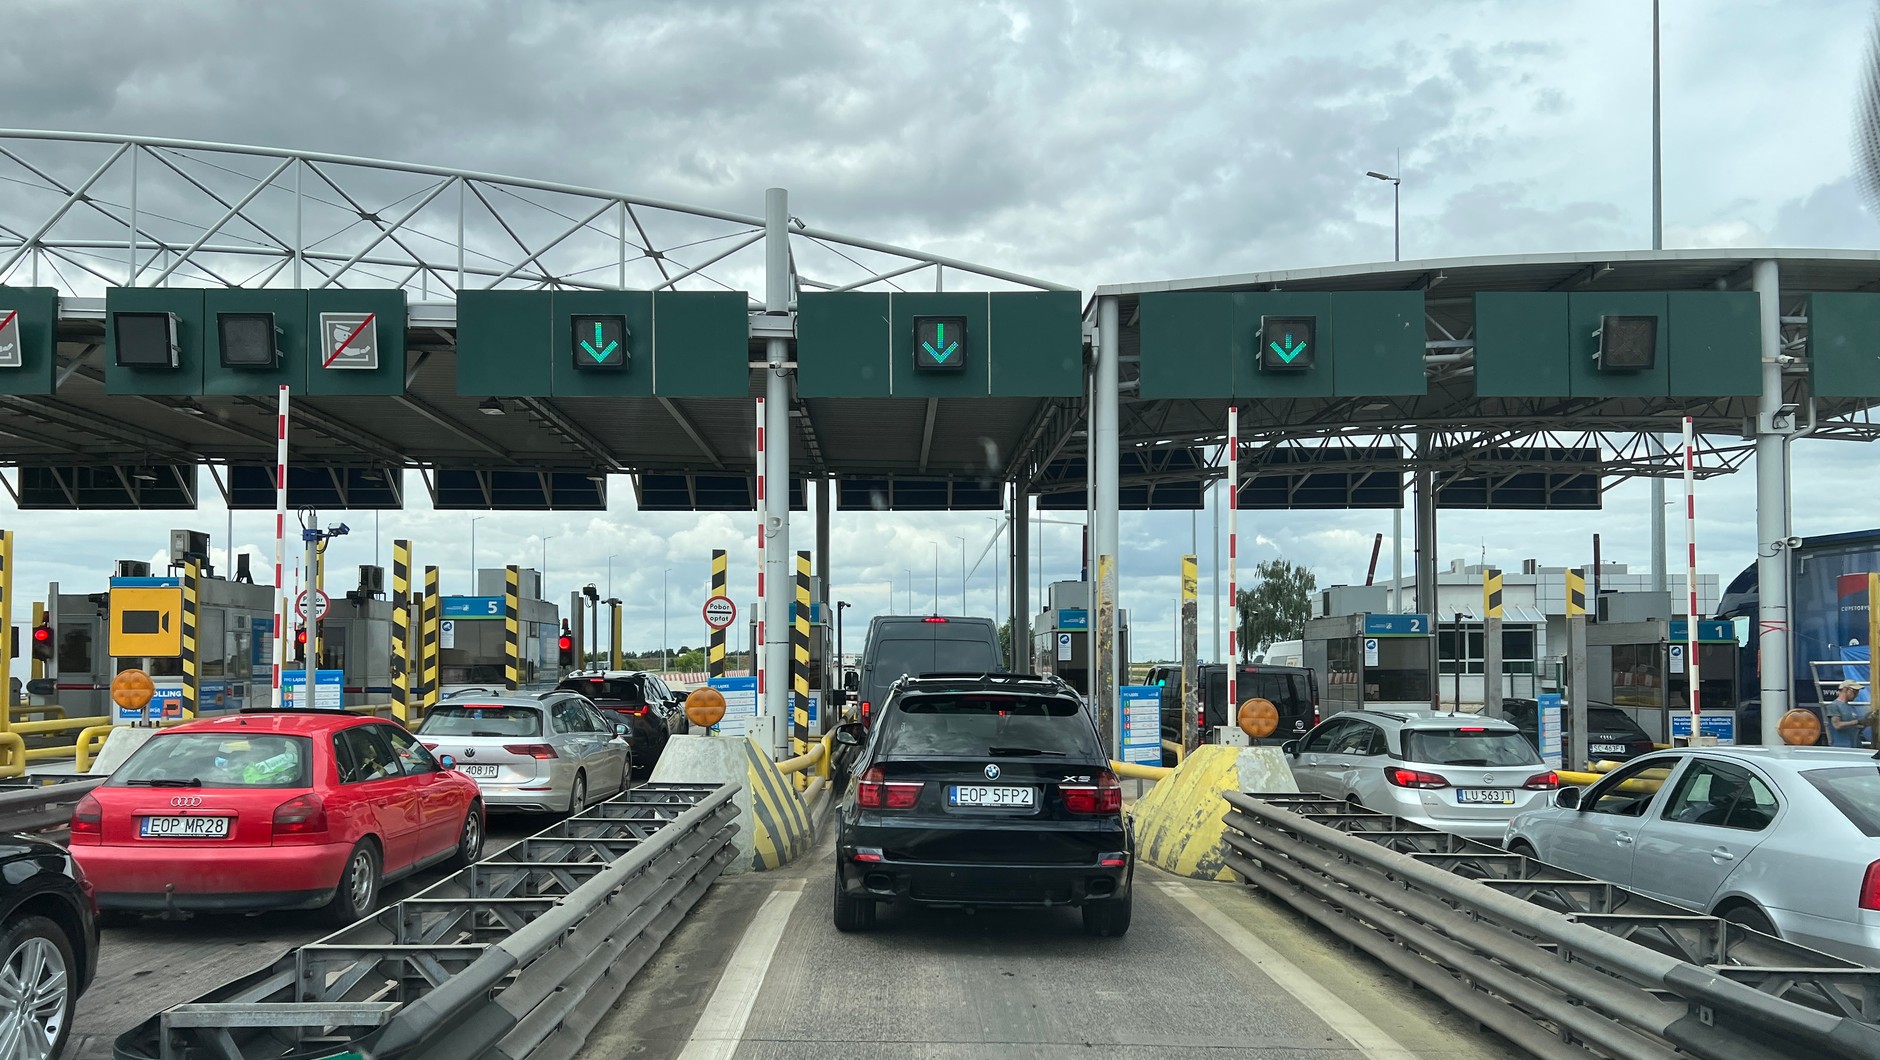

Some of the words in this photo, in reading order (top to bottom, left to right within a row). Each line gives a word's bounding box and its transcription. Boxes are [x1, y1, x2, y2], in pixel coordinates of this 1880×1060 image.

[488, 601, 498, 614] 5
[1410, 619, 1420, 632] 2
[1715, 626, 1723, 638] 1
[466, 766, 495, 776] 408JR
[960, 788, 988, 802] EOP
[993, 788, 1029, 803] 5FP2
[1465, 790, 1479, 800] LU
[1481, 790, 1512, 800] 563JT
[151, 818, 180, 832] EOP
[184, 819, 224, 833] MR28
